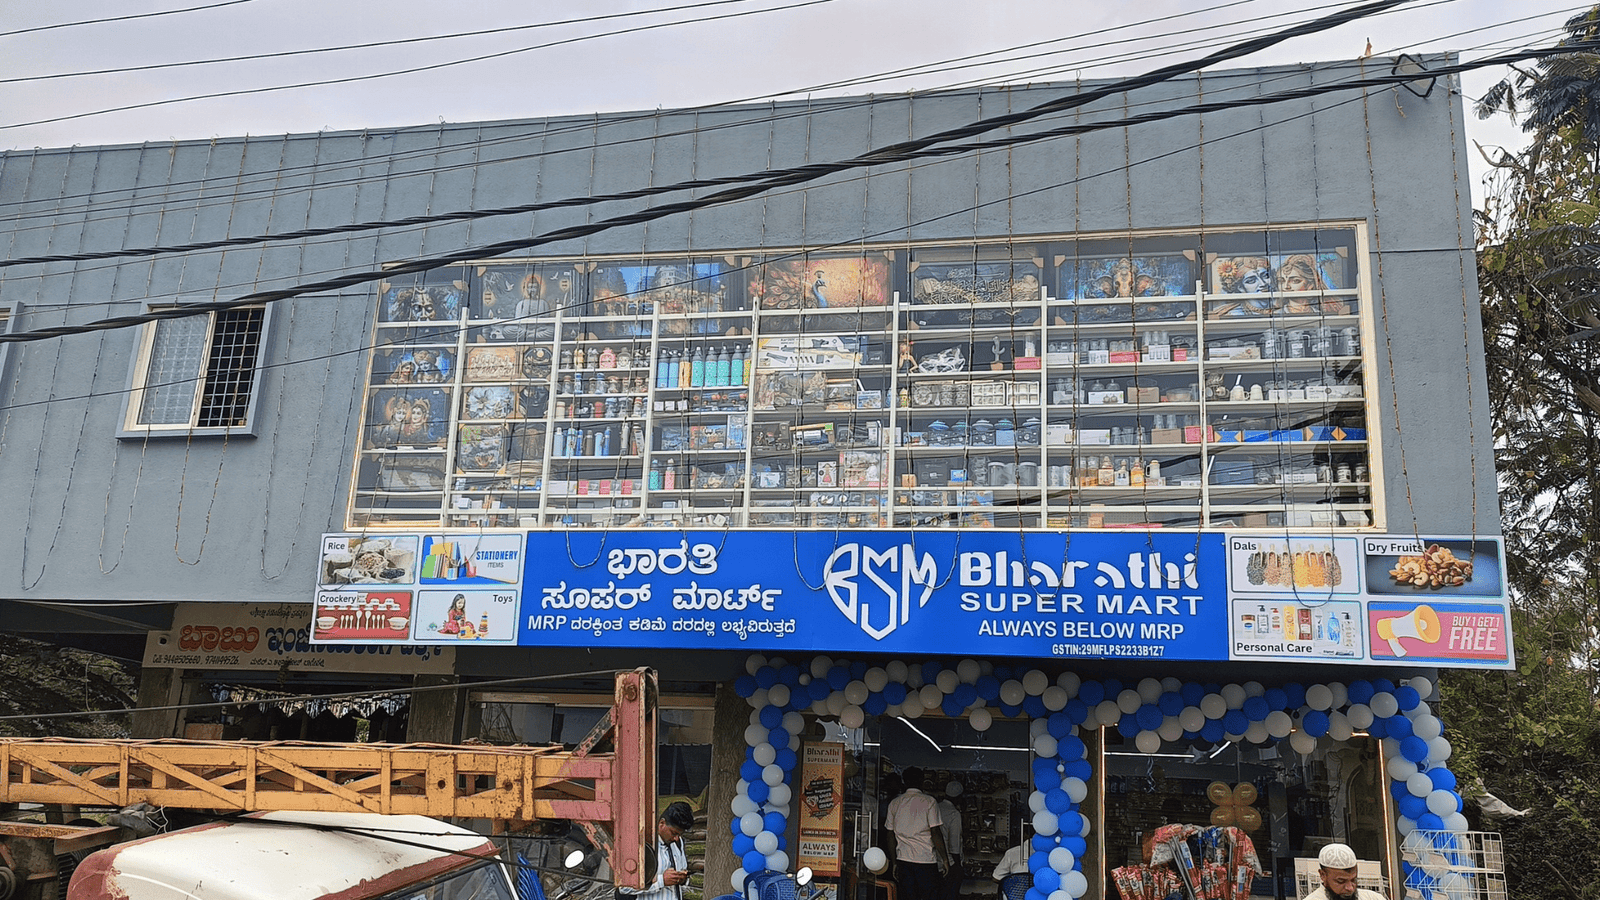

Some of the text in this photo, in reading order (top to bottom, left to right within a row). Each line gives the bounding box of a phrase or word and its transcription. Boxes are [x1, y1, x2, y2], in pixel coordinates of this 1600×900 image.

[328, 542, 345, 550] Rice
[1233, 541, 1257, 551] Dals
[1367, 542, 1423, 554] Dry Fruits
[476, 551, 518, 561] STATIONERY
[607, 540, 718, 579] ಭಾರತಿ
[960, 550, 1199, 590] Bharathi
[541, 581, 782, 611] ಸೂಪರ್ ಮಾರ್ಟ್
[823, 543, 937, 641] BSM
[320, 595, 357, 604] Crockery
[493, 594, 513, 604] Toys
[960, 592, 1204, 616] SUPER MART
[1452, 615, 1471, 626] BUY
[1477, 616, 1495, 627] GET
[528, 615, 796, 641] MRP ದರಕ್ಕಿಂತ ಕಡಿಮೆ ದರದಲ್ಲಿ ಲಭ್ಯವಿರುತ್ತದೆ
[978, 620, 1184, 640] ALWAYS BELOW MRP
[1448, 627, 1498, 651] FREE
[1236, 642, 1283, 653] Personal
[1286, 643, 1313, 653] Care
[807, 747, 839, 756] Bharathi
[802, 843, 836, 851] ALWAYS
